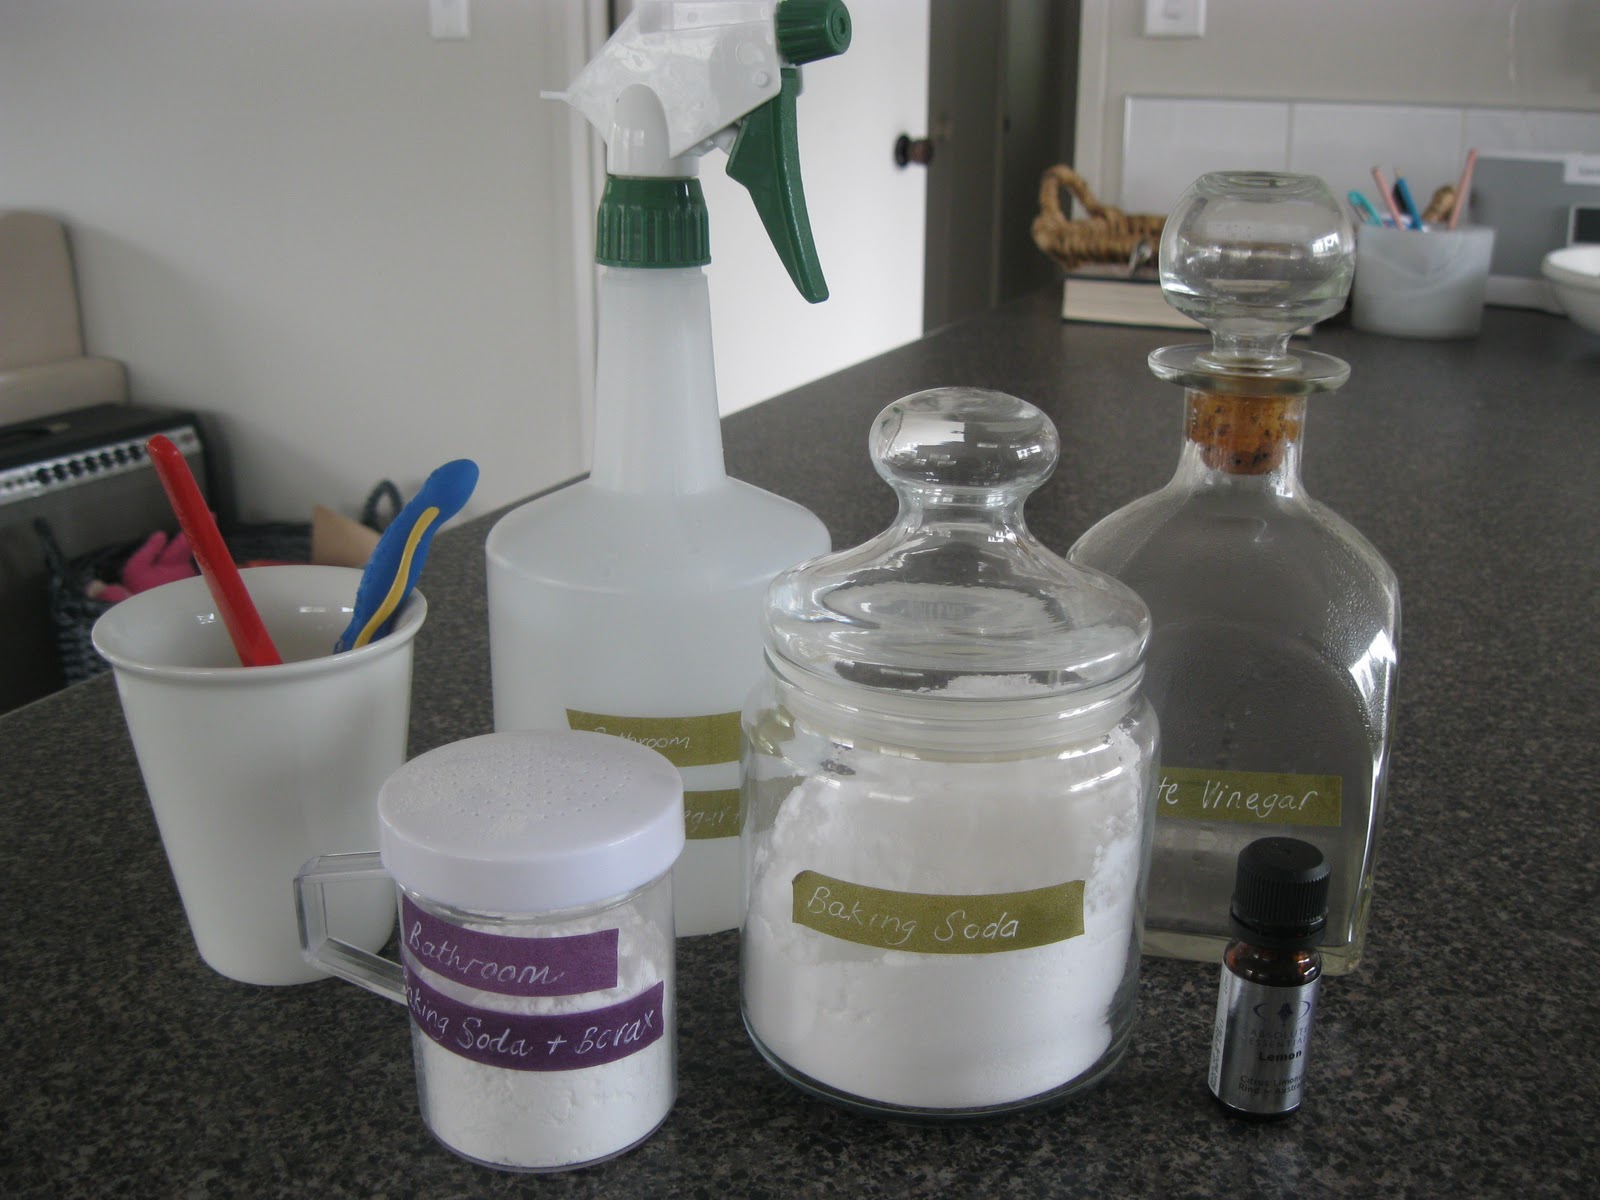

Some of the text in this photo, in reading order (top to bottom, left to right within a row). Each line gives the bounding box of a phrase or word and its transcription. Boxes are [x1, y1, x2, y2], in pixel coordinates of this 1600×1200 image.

[1202, 780, 1318, 818] Vinegar
[807, 886, 1020, 946] Baking Soda
[408, 921, 565, 985] Bathroom
[457, 1017, 533, 1057] Soda
[547, 1035, 568, 1055] +
[1258, 1049, 1303, 1063] Lemon
